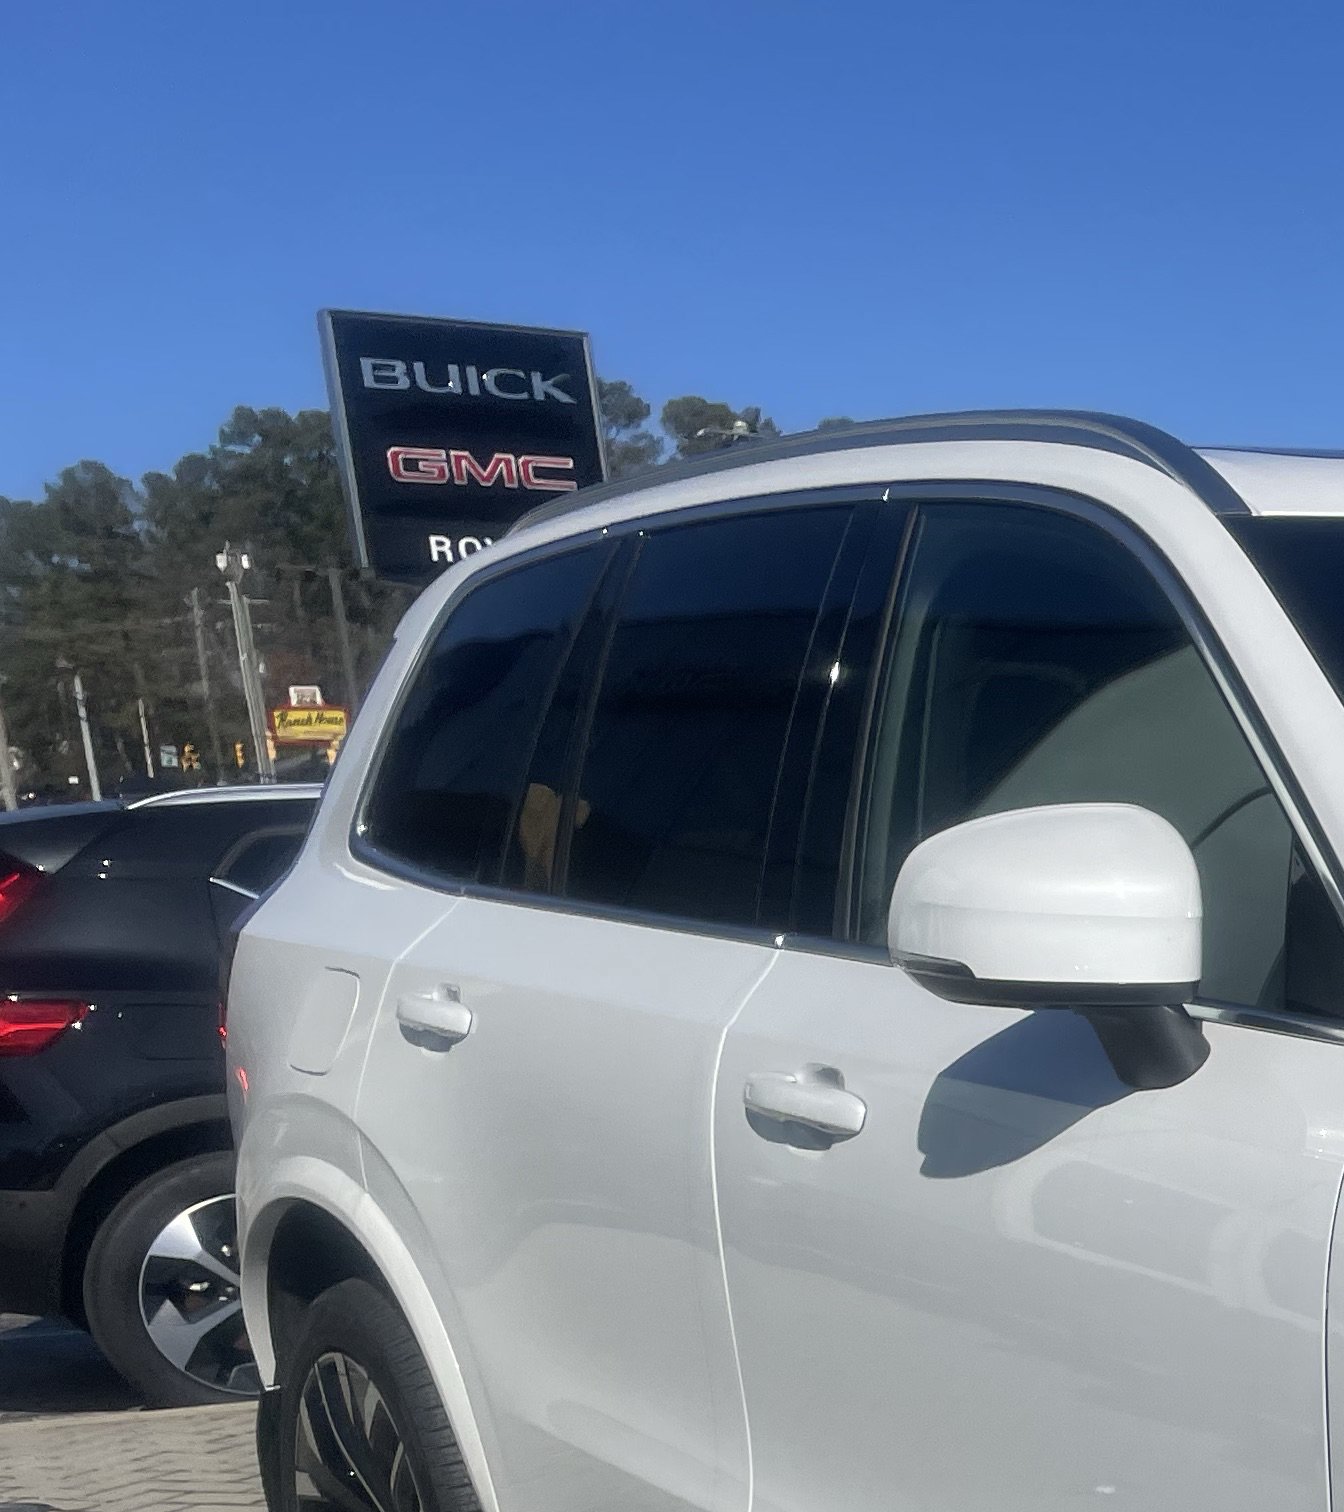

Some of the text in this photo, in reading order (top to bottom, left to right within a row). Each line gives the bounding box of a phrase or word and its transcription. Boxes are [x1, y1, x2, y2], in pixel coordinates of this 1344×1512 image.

[359, 356, 577, 404] BUICK
[386, 446, 579, 492] GMC
[428, 534, 495, 563] RO
